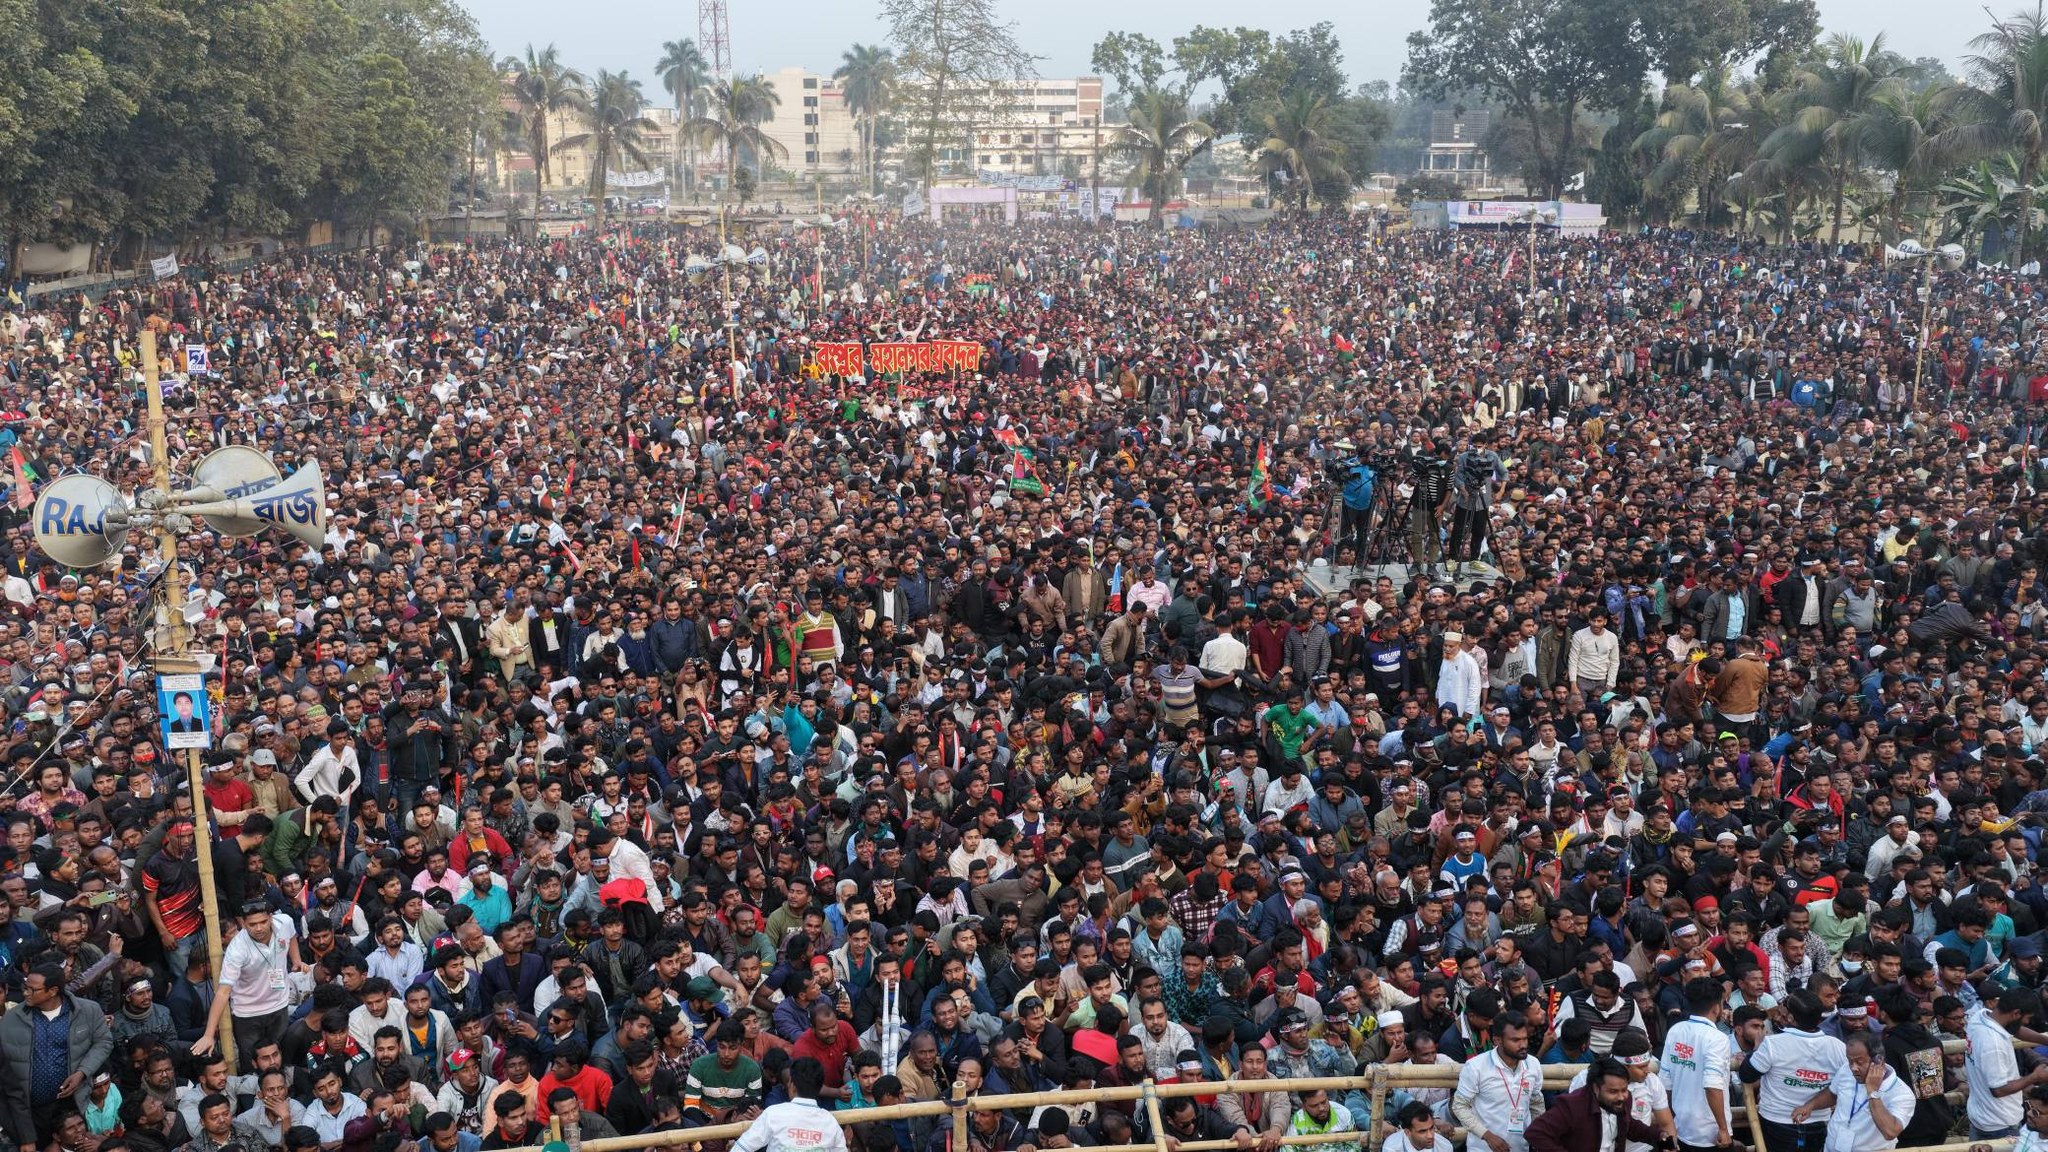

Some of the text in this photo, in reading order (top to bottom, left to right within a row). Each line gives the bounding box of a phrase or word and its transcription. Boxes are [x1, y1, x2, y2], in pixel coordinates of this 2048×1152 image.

[1887, 253, 1907, 264] RAJ
[815, 340, 980, 377] রংপুর মহানগর যুবদল
[251, 487, 319, 527] রাজ
[1796, 1069, 1829, 1081] সবার
[787, 1128, 823, 1142] সবার
